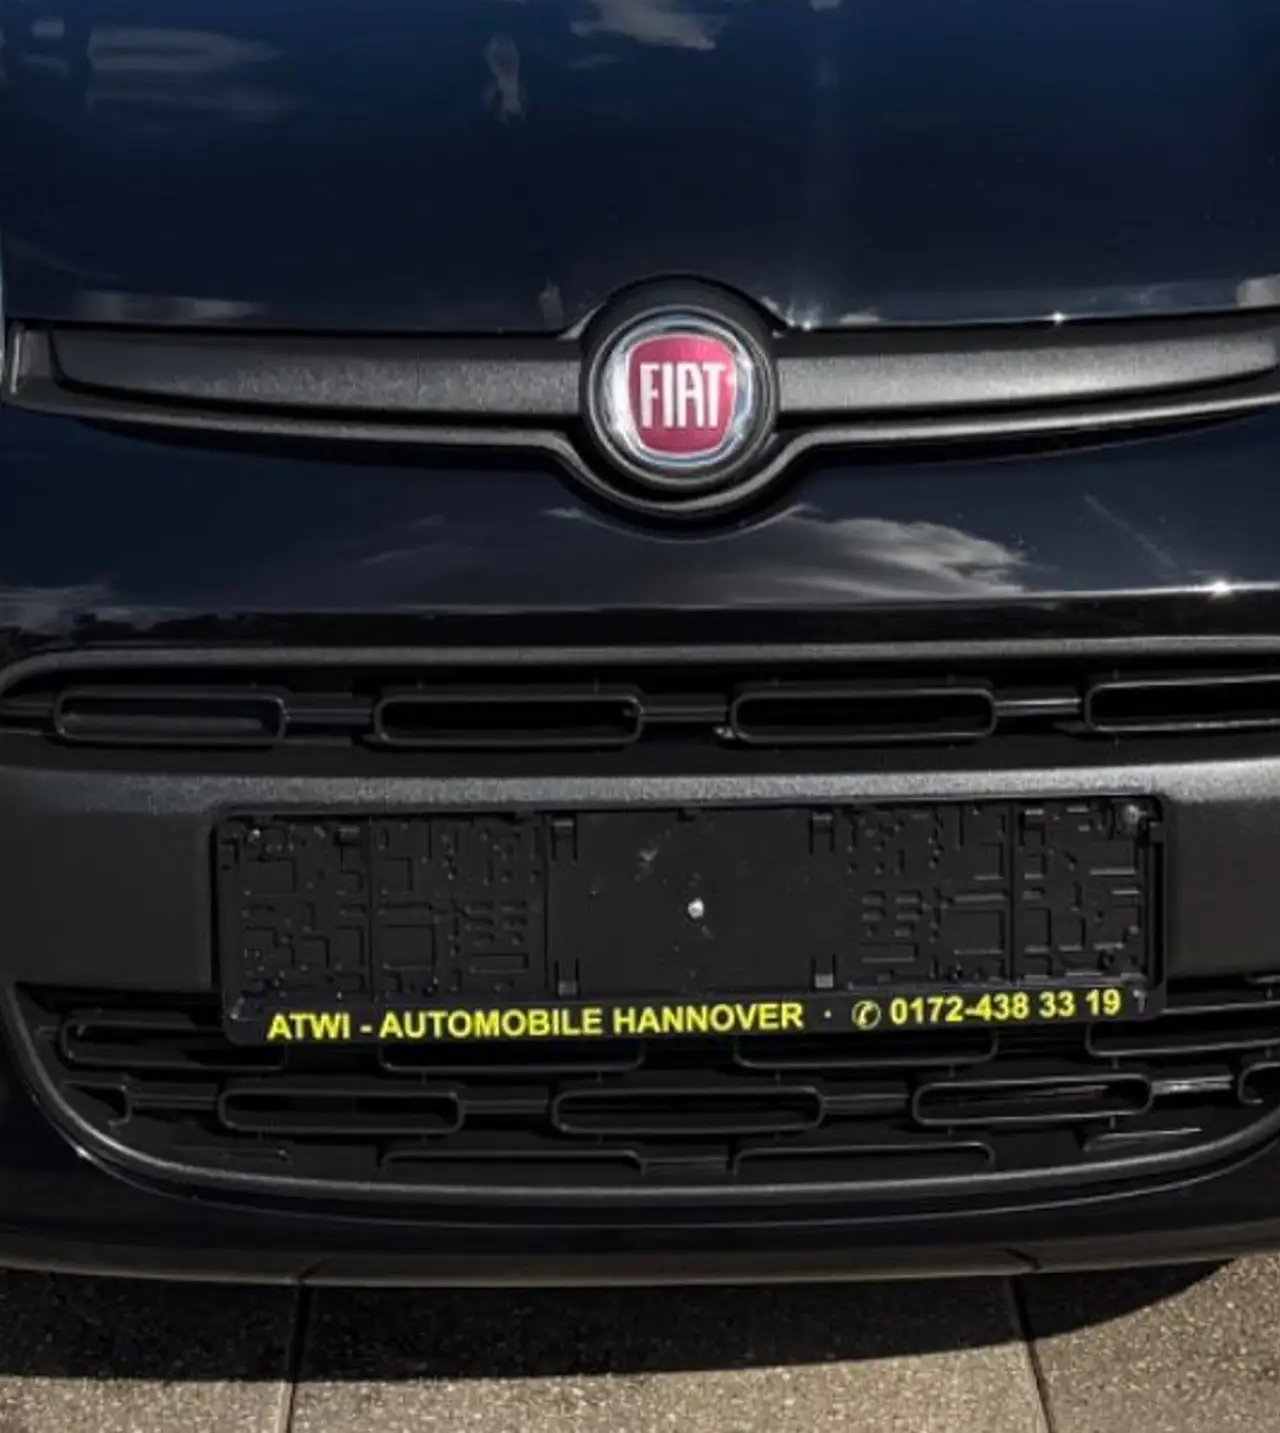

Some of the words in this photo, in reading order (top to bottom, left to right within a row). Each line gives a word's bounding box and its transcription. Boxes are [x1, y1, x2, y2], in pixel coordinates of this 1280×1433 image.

[639, 361, 728, 429] FIAT
[268, 1012, 351, 1040] ATWI
[380, 1008, 602, 1039] AUTOMOBILE
[613, 1003, 803, 1034] HANNOVER
[890, 993, 1030, 1025] 0172-438
[1039, 992, 1076, 1019] 33
[1086, 990, 1122, 1017] 19
